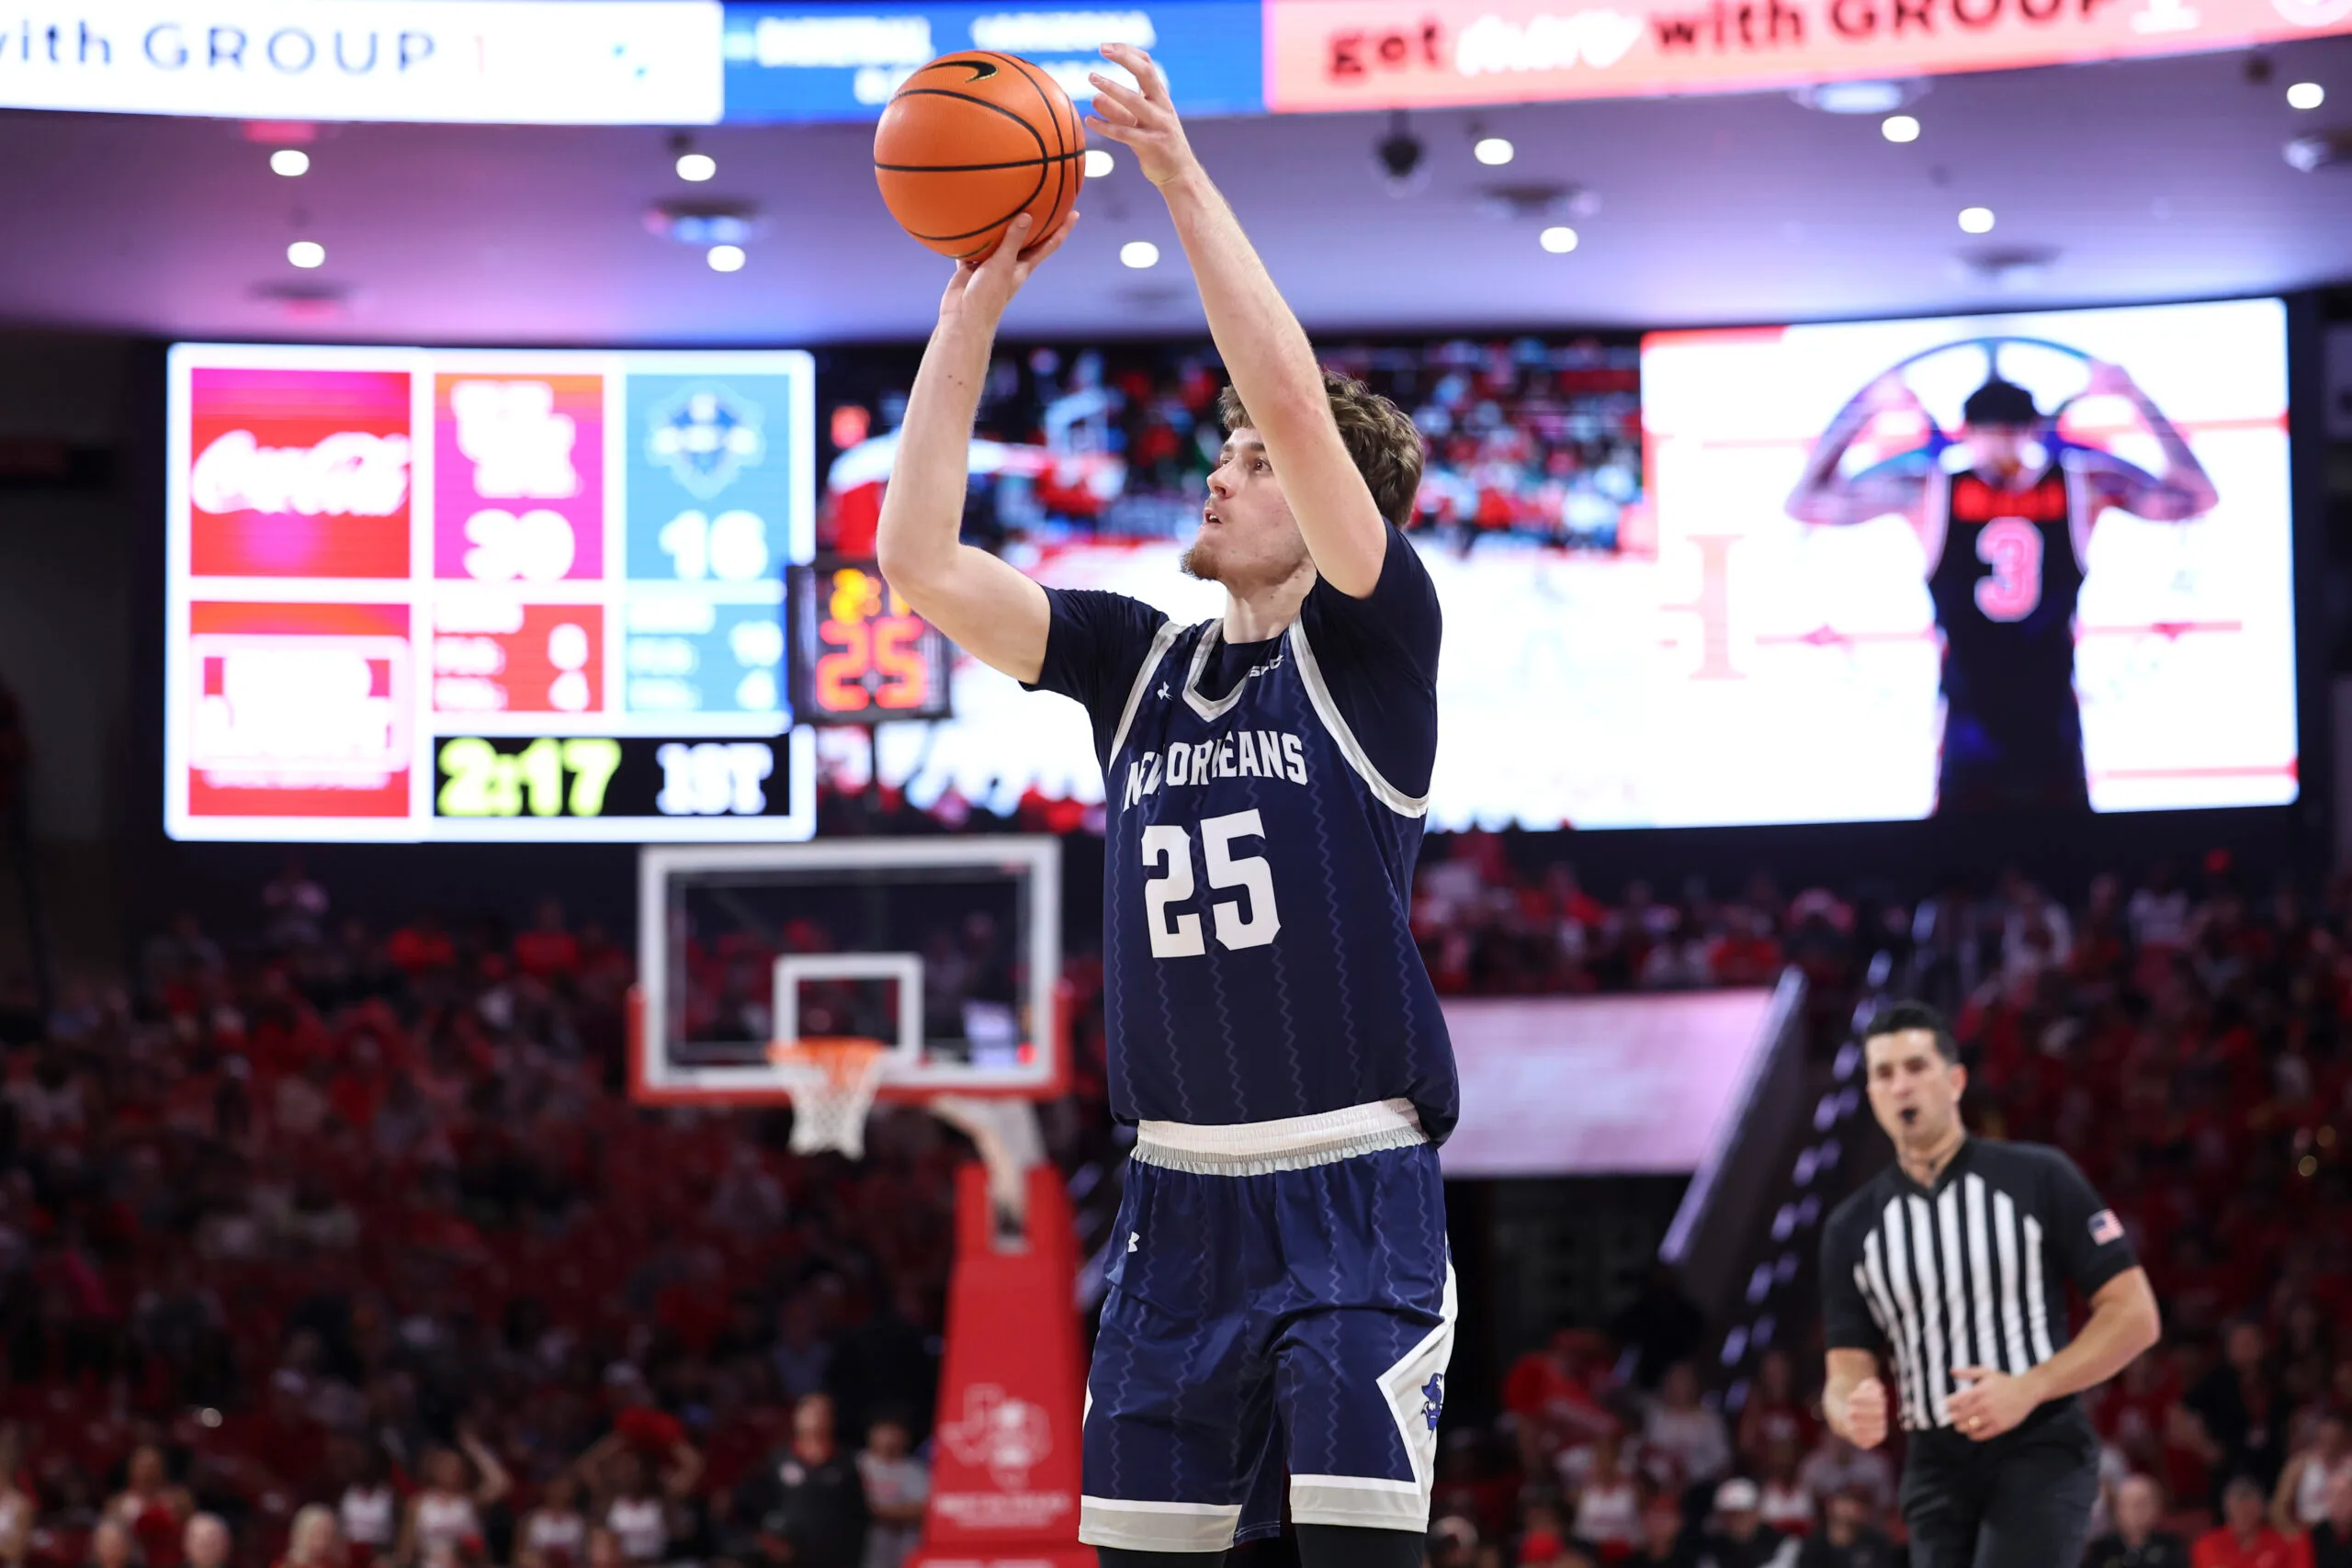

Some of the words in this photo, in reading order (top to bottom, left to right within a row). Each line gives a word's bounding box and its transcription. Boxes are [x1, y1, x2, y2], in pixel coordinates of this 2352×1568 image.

[0, 18, 111, 64] ith
[142, 22, 435, 75] GROUP
[1974, 516, 2044, 623] 3
[816, 616, 929, 711] 25
[437, 737, 621, 817] 2:17
[1140, 808, 1282, 958] 25
